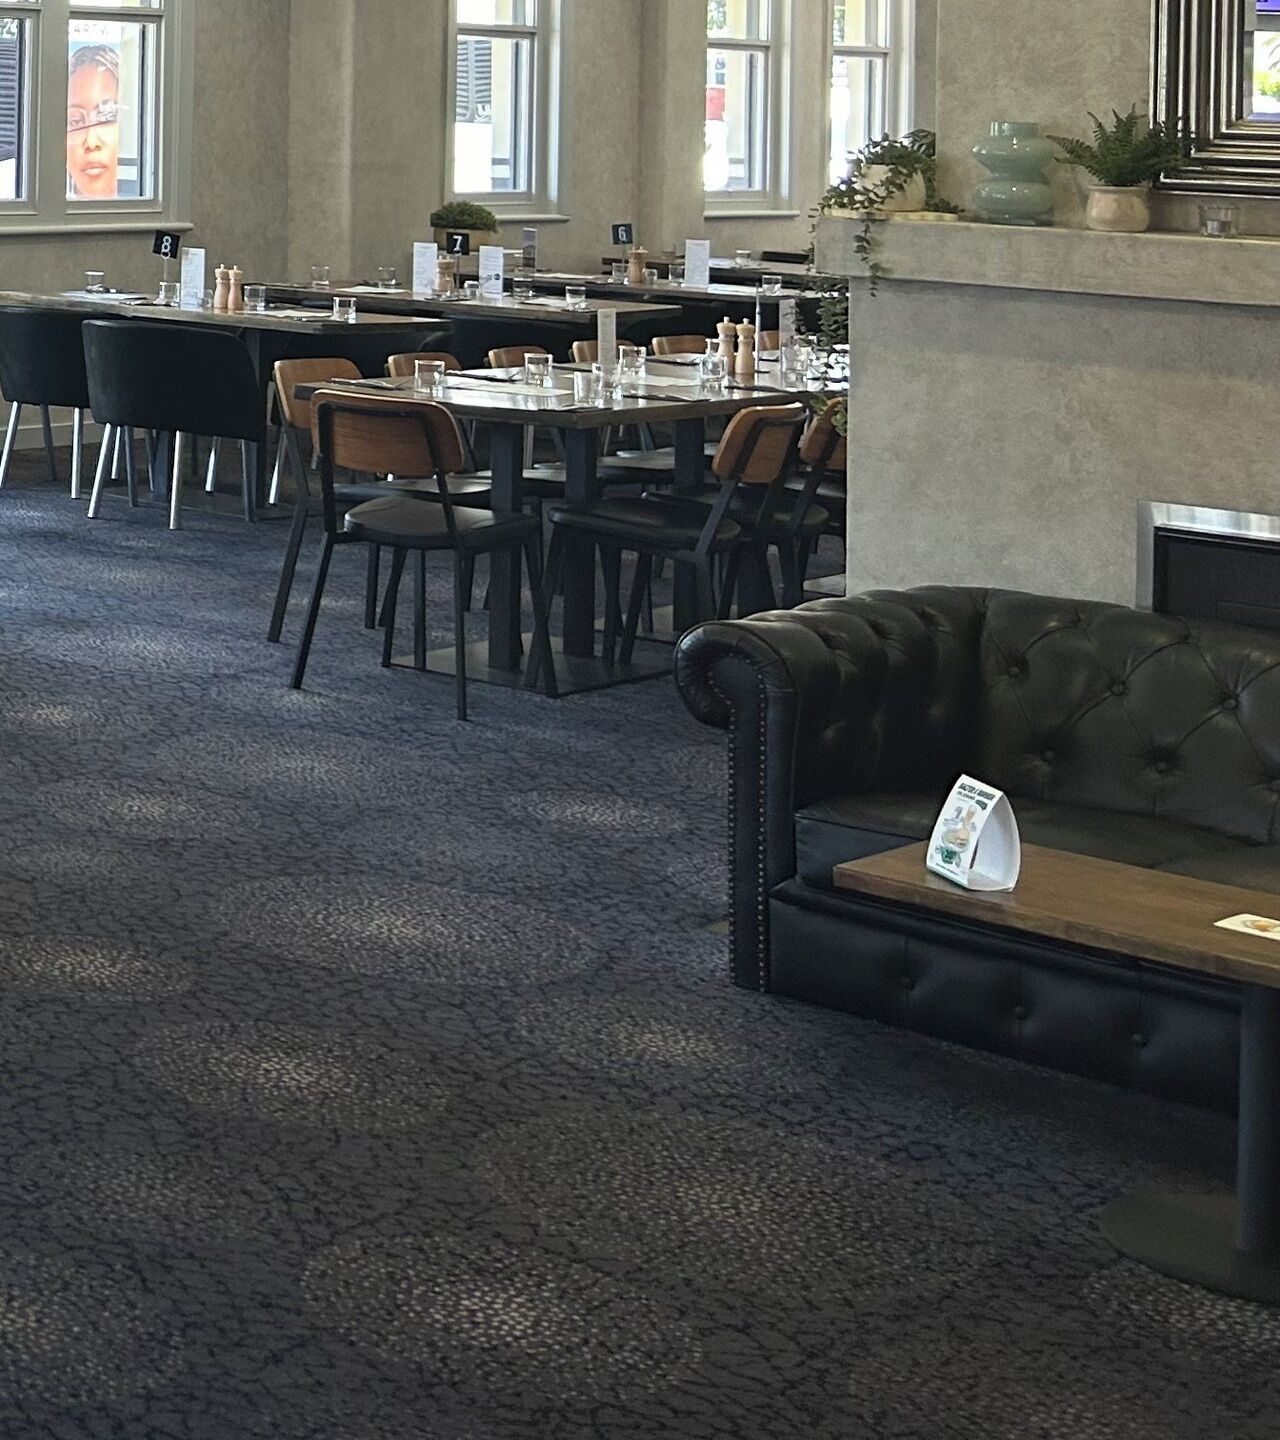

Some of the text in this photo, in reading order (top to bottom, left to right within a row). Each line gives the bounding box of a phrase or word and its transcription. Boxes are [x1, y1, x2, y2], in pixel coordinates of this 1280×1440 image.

[618, 226, 627, 241] 6
[161, 235, 171, 252] 8
[453, 235, 462, 251] 7
